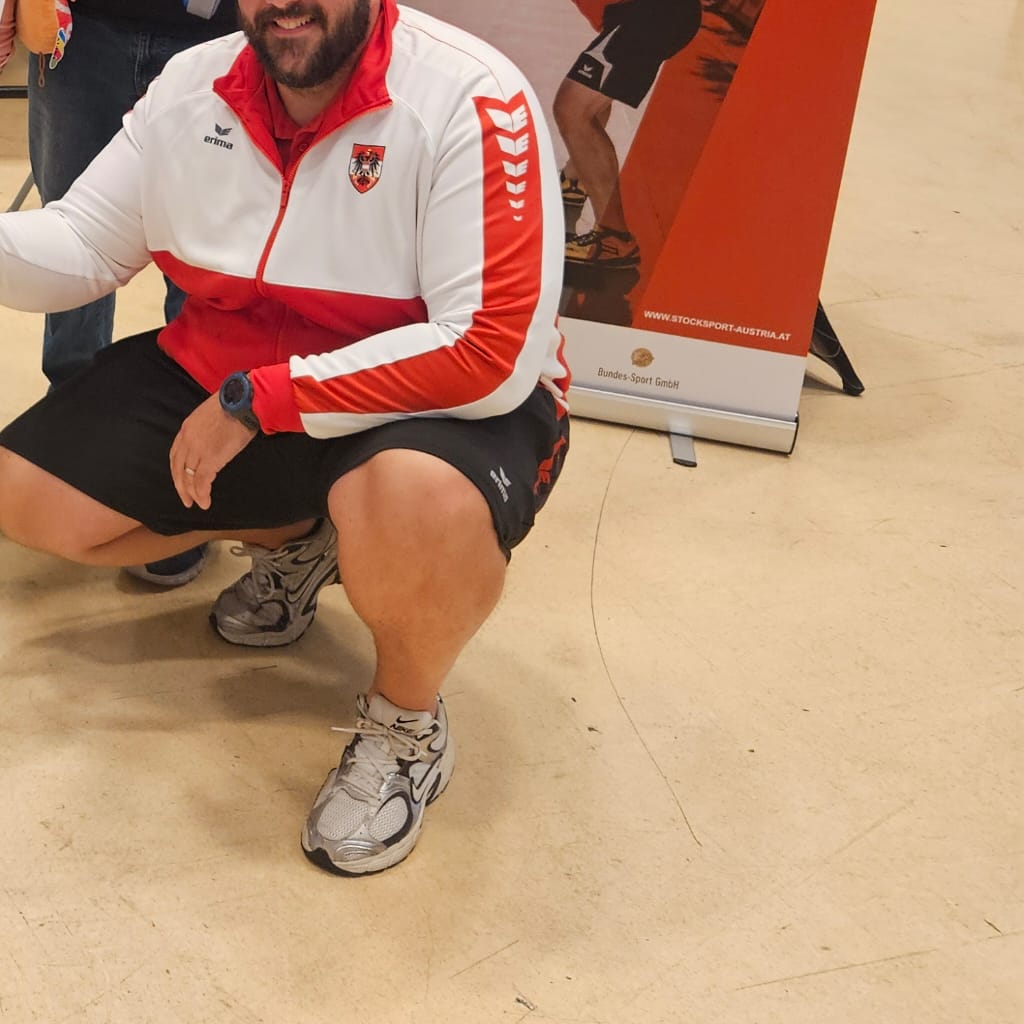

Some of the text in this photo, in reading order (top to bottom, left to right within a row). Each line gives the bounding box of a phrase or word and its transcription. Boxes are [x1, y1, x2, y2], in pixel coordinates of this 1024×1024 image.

[203, 136, 233, 150] erima
[644, 310, 791, 341] WWW.STOCKSPORT-AUSTRIA.AT
[597, 367, 680, 390] Bundes-Sport GmbH
